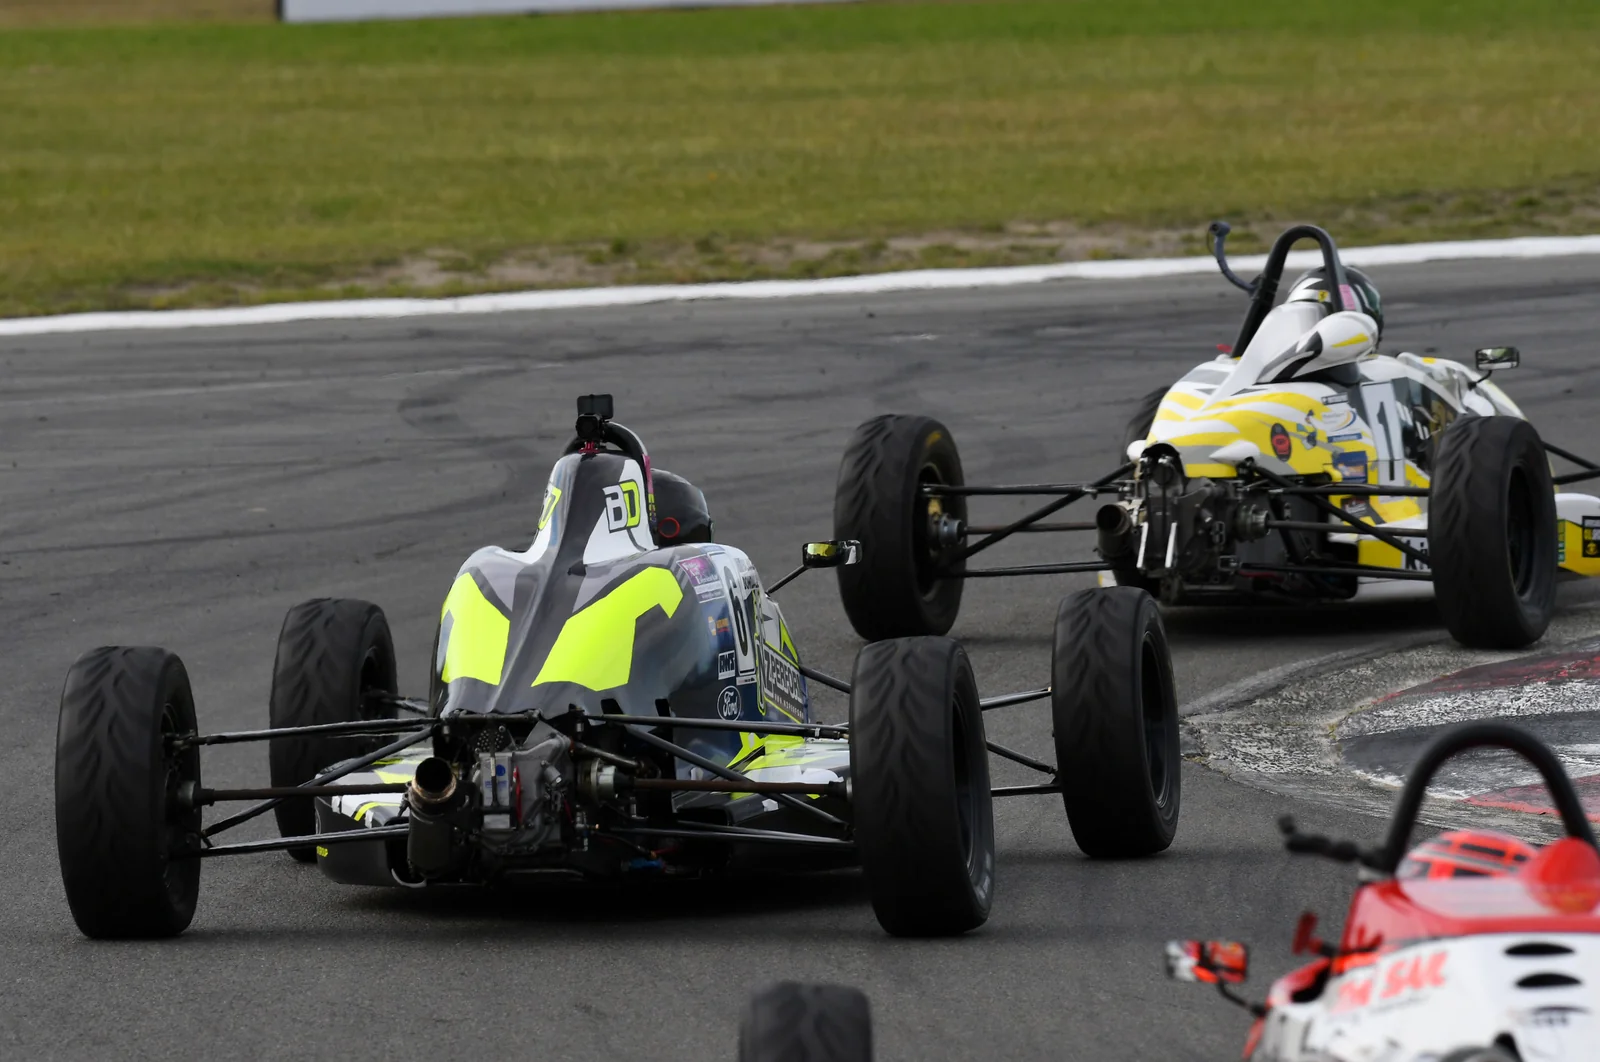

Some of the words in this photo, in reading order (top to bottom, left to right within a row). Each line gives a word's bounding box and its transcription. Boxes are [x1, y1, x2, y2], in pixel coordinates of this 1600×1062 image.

[1376, 401, 1395, 481] 1
[602, 479, 641, 533] BD
[723, 565, 749, 657] 6
[721, 689, 740, 718] Ford
